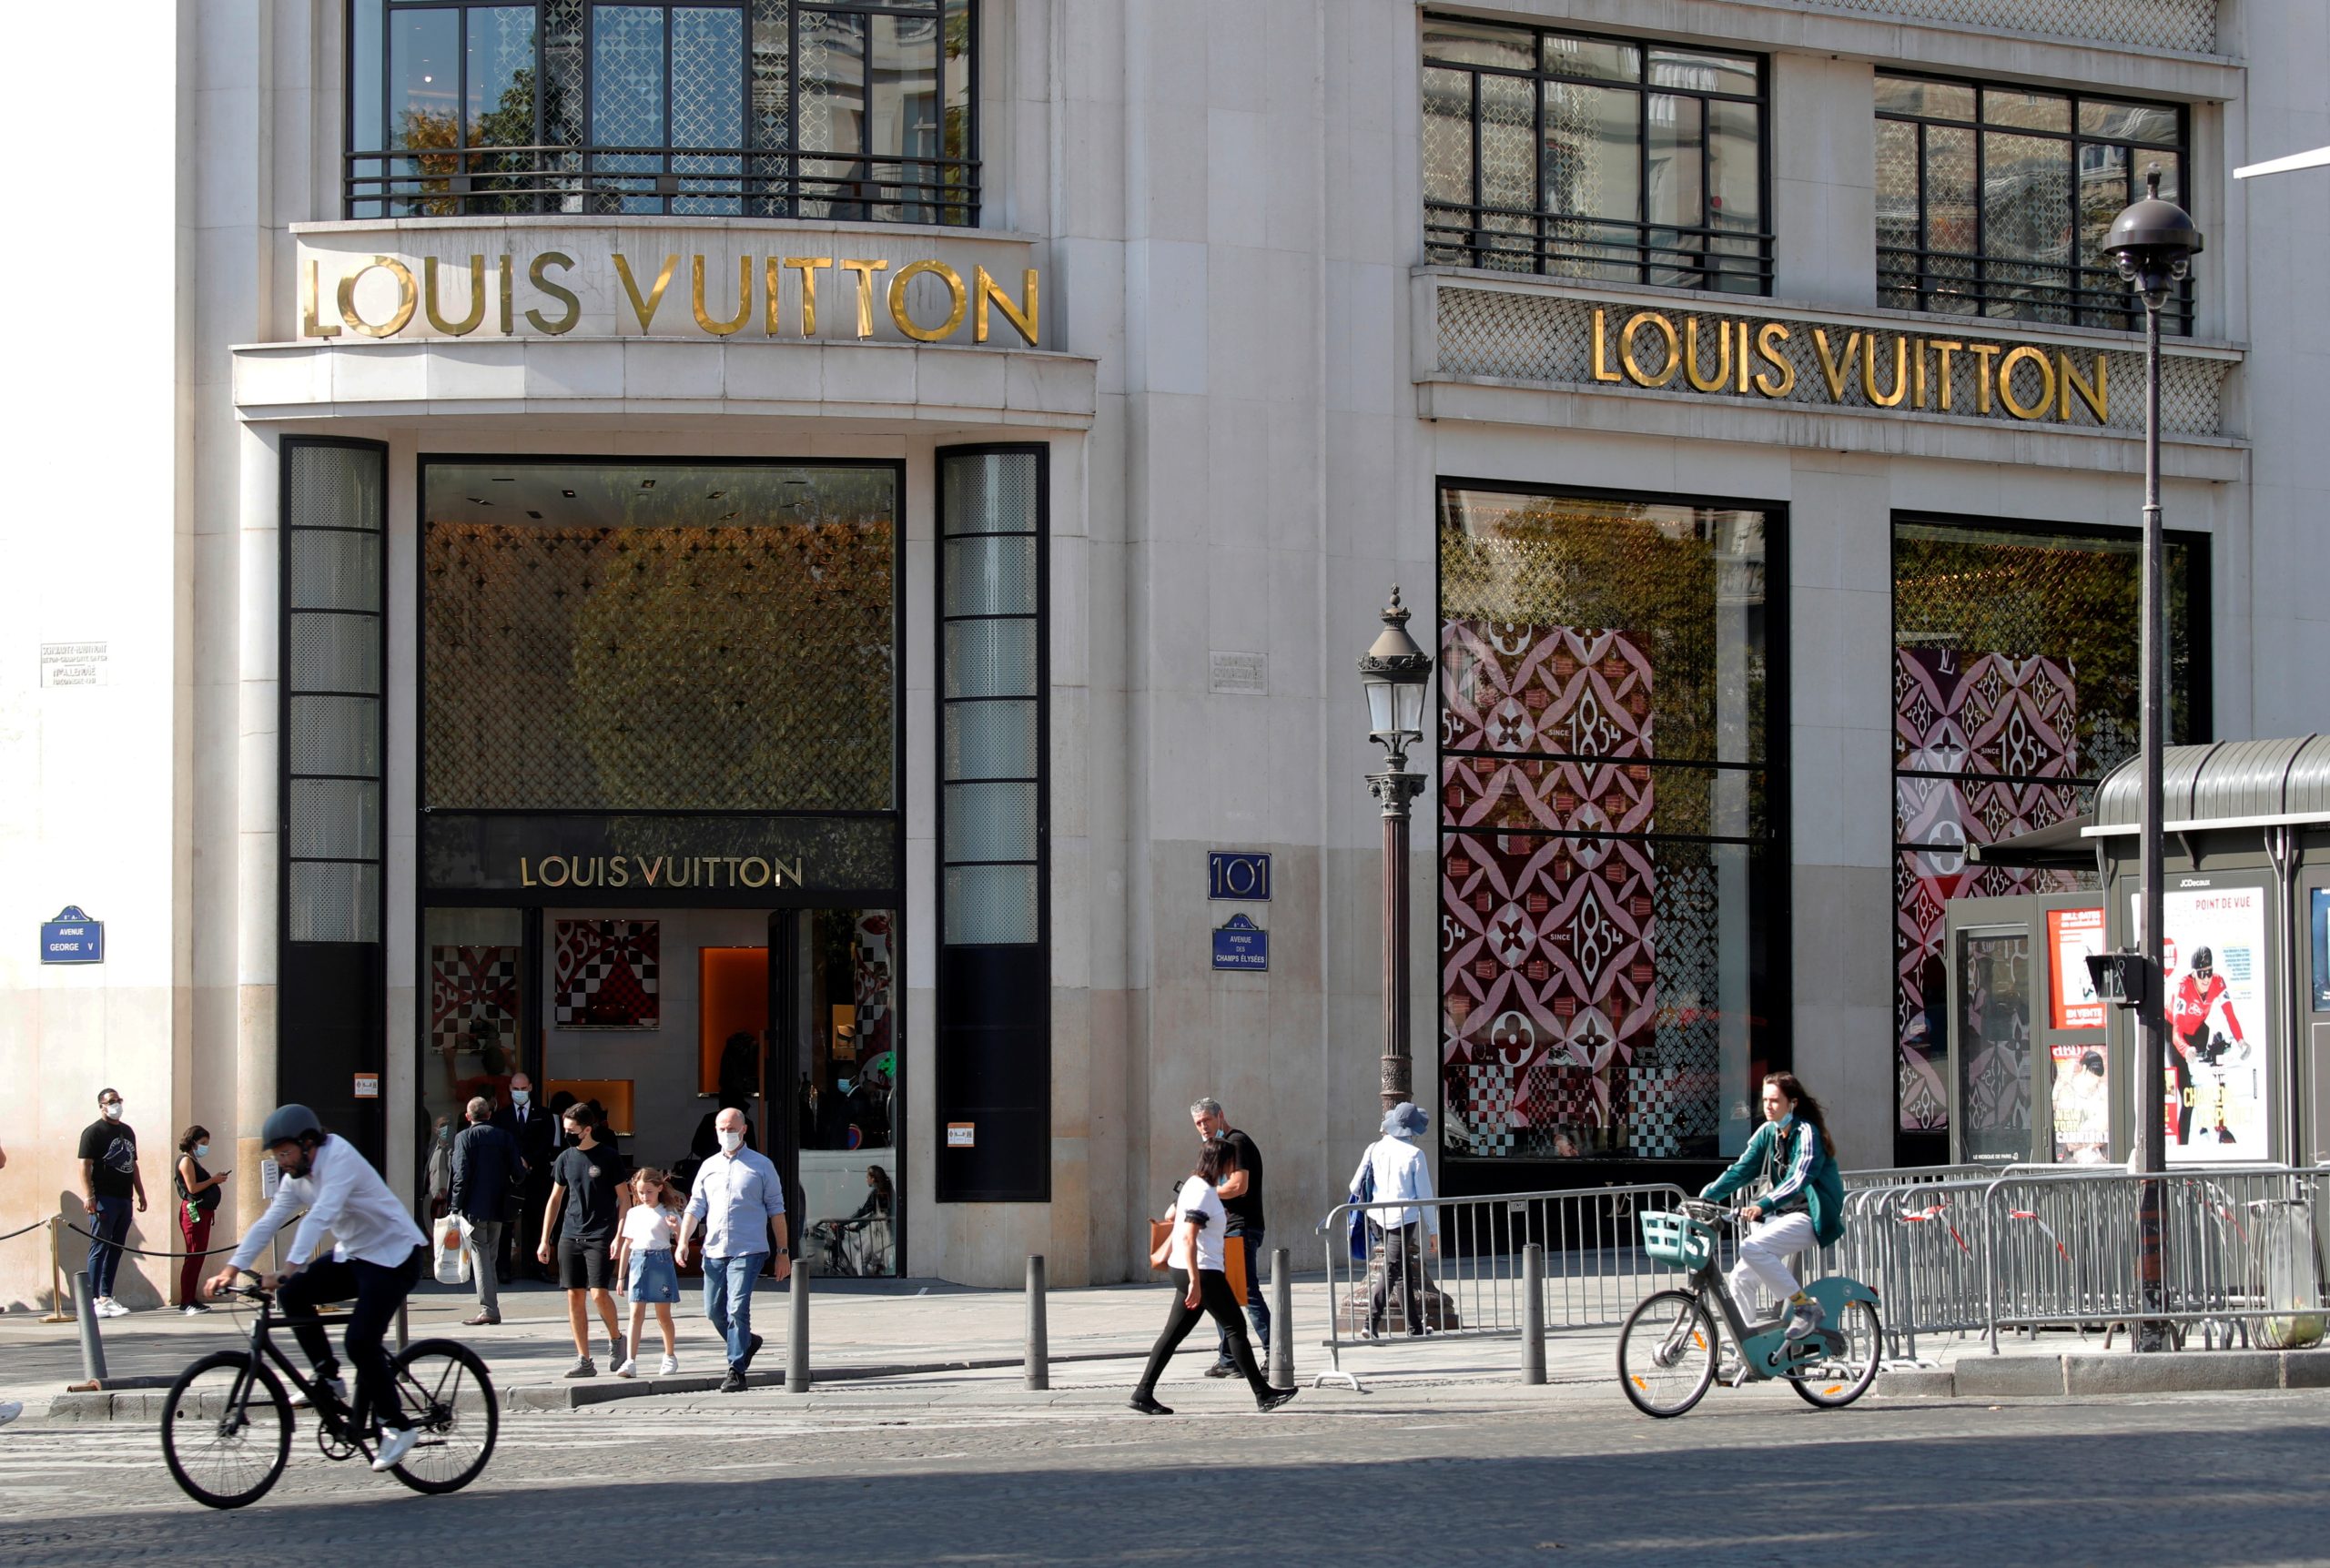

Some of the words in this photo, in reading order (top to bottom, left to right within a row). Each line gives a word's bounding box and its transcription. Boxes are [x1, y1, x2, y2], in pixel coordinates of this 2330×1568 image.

[304, 251, 581, 338] LOUIS
[612, 253, 1038, 348] VUITTON
[1589, 309, 1795, 399] LOUIS
[1810, 329, 2108, 425] VUITTON
[1548, 728, 1570, 737] SINCE
[1566, 686, 1621, 782] 1854
[1980, 747, 2001, 755] SINCE
[1995, 706, 2048, 798] 1854
[521, 855, 629, 887] LOUIS
[638, 855, 802, 887] VUITTON
[1212, 857, 1266, 895] 101
[2180, 879, 2211, 888] JCDecaux
[2195, 898, 2220, 910] POINT
[2222, 897, 2232, 908] DE
[2234, 896, 2251, 907] VUE
[49, 943, 79, 952] GEORGE
[87, 942, 94, 951] V
[59, 927, 85, 936] AVENUE
[1230, 936, 1252, 944] AVENUE
[1550, 933, 1571, 941] SINCE
[1566, 889, 1623, 986] 1854
[1241, 954, 1265, 963] ÉLYSÉES
